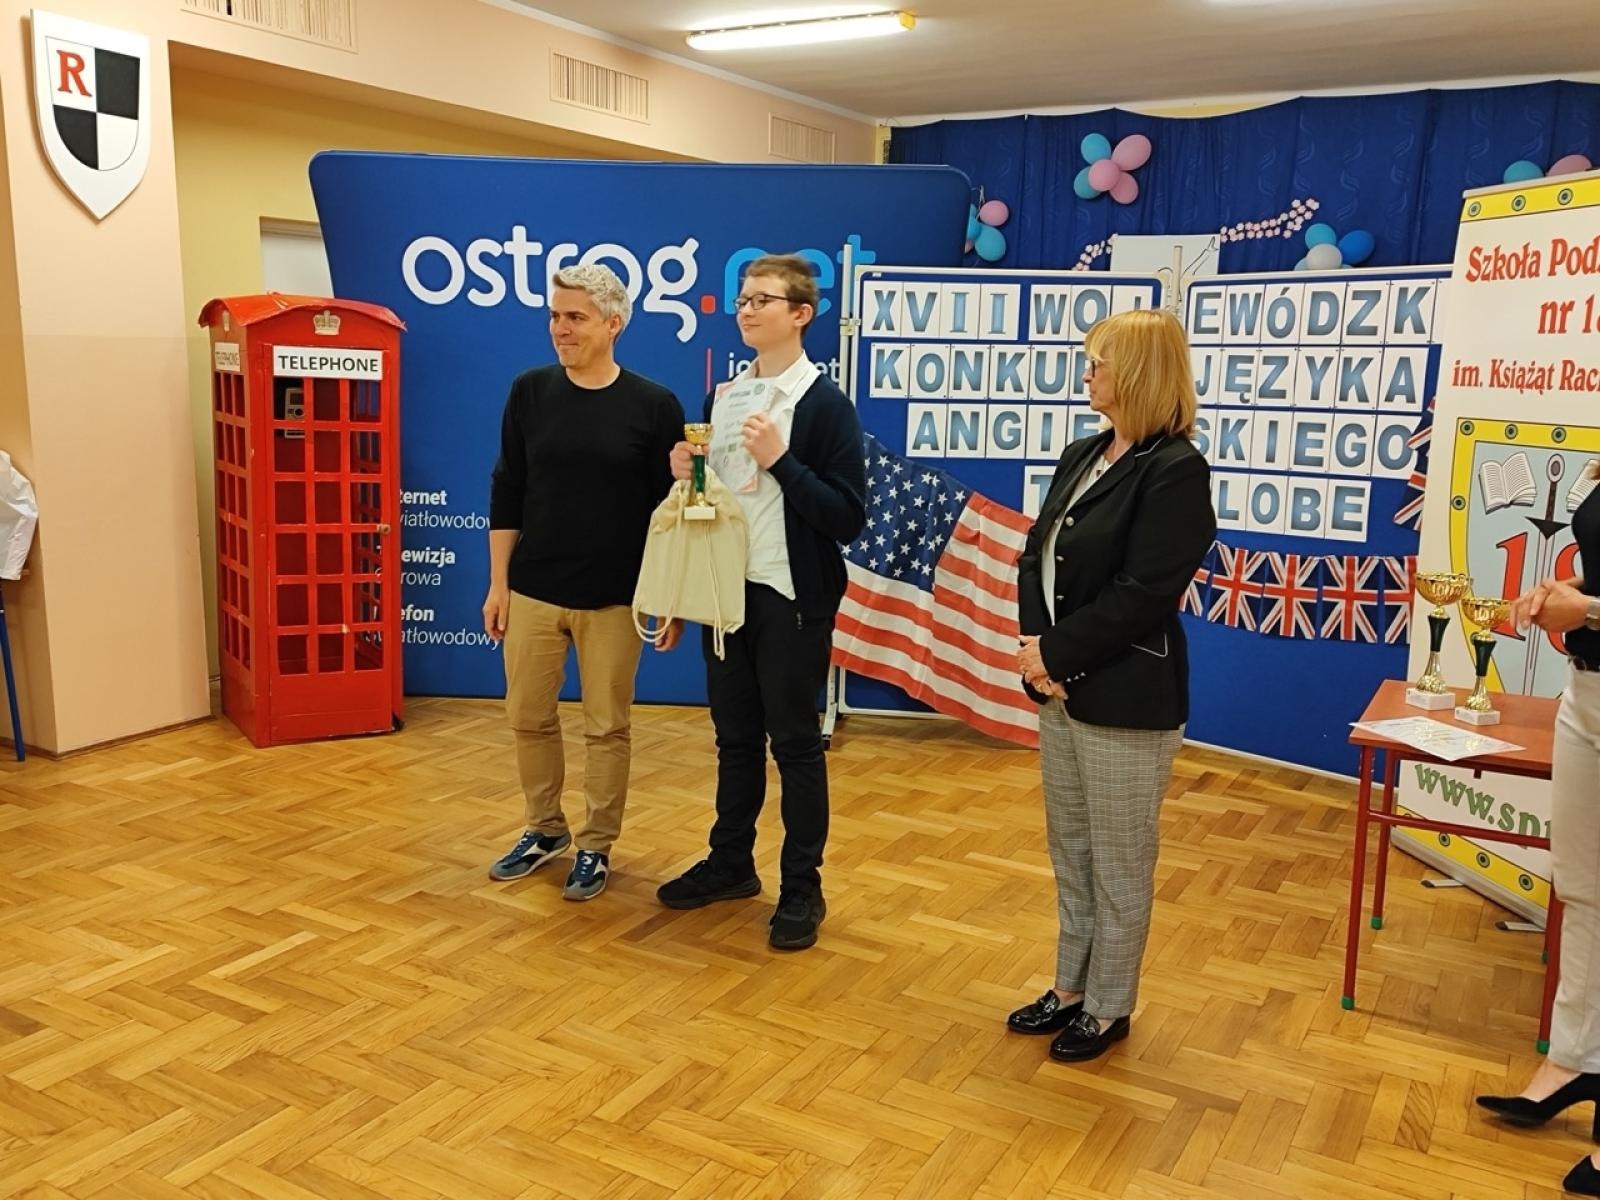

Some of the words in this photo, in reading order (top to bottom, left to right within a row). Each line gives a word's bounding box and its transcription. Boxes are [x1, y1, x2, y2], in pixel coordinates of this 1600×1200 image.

[56, 49, 93, 97] R
[1465, 242, 1541, 283] Szkoła
[1547, 237, 1600, 276] Pod
[872, 289, 1009, 335] XVII
[1537, 300, 1575, 334] nr
[1582, 294, 1600, 334] 1
[278, 354, 379, 373] TELEPHONE
[1195, 354, 1417, 404] JĘZYKA
[1452, 359, 1482, 388] im.
[1489, 358, 1555, 395] Książąt
[1559, 359, 1600, 393] Rac
[1217, 479, 1366, 532] LOBE
[400, 571, 441, 586] rowa
[401, 546, 456, 568] ewizja
